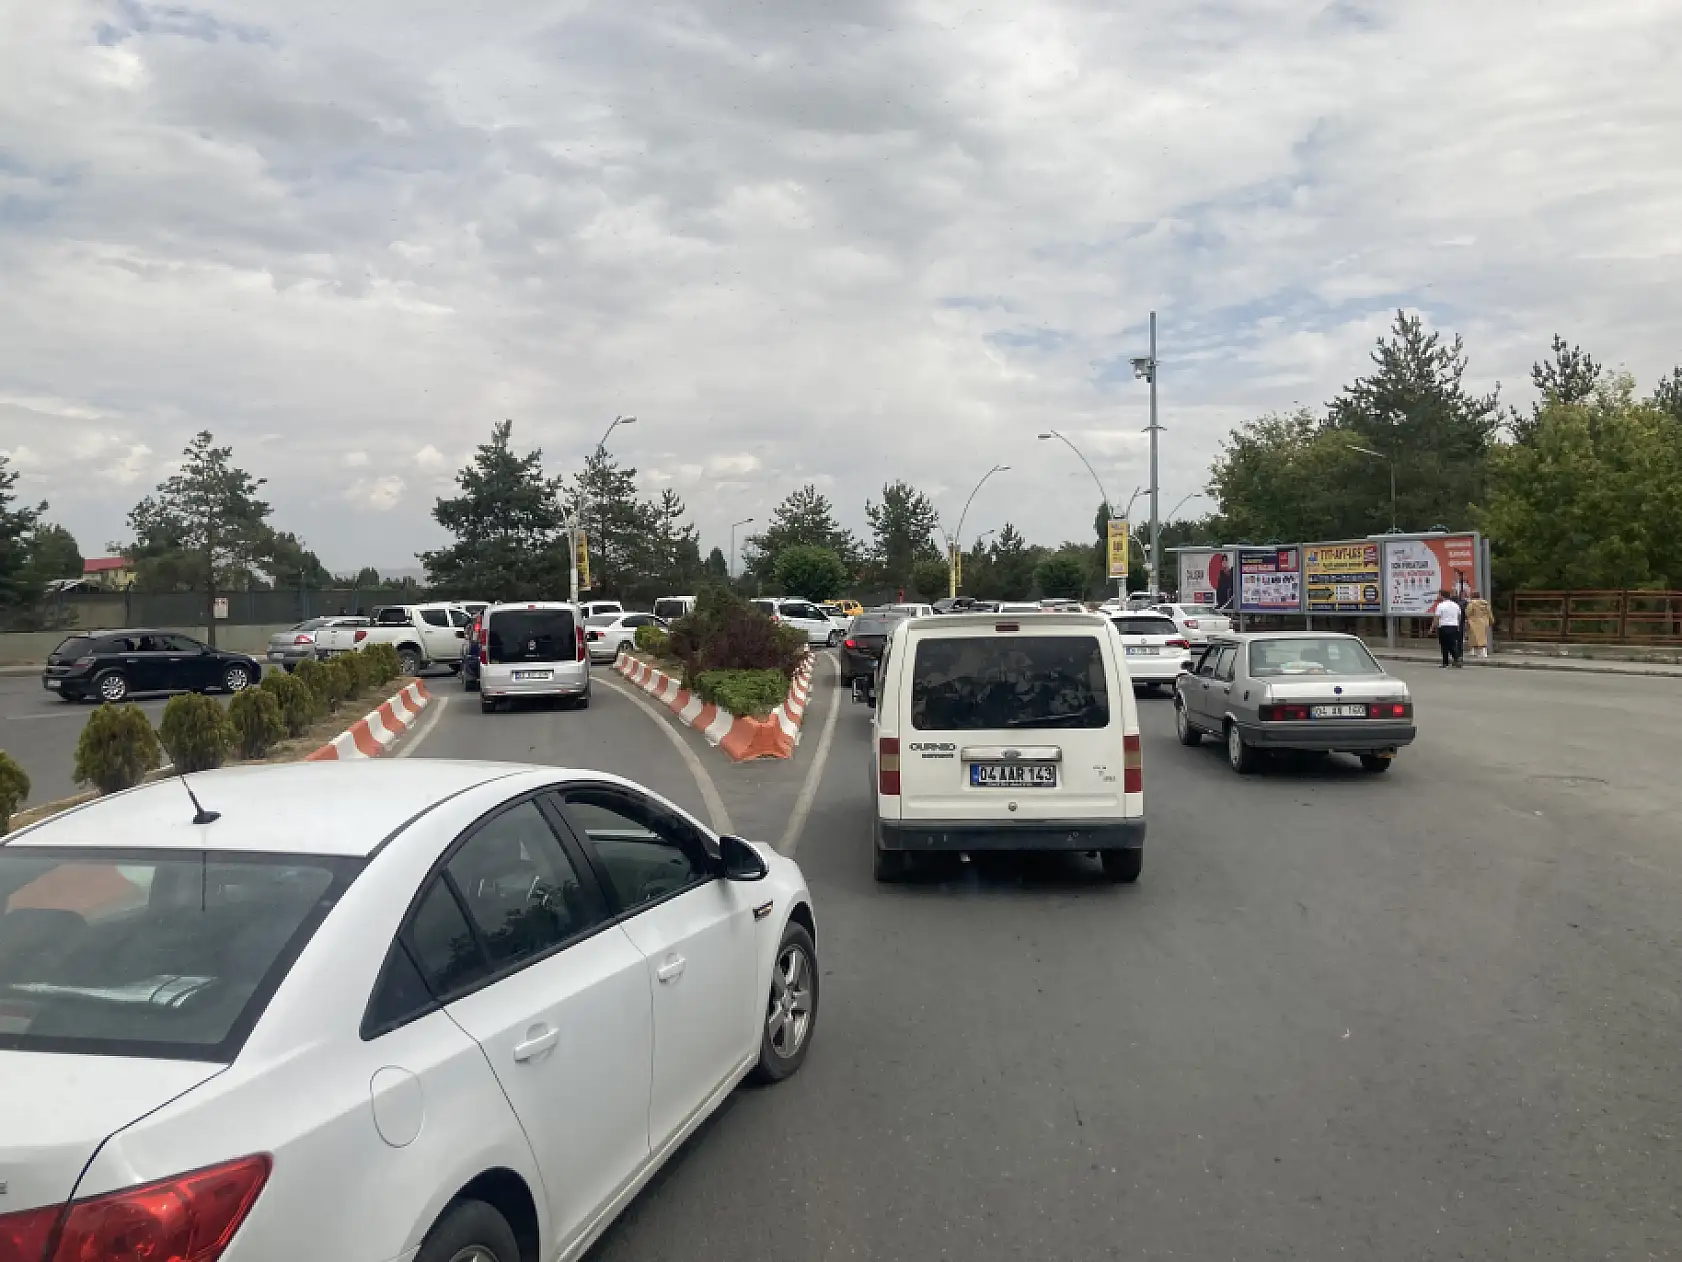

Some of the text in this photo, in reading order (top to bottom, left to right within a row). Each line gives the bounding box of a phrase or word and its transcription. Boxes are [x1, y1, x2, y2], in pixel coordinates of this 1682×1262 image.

[980, 766, 1053, 781] 04 AAR 143
